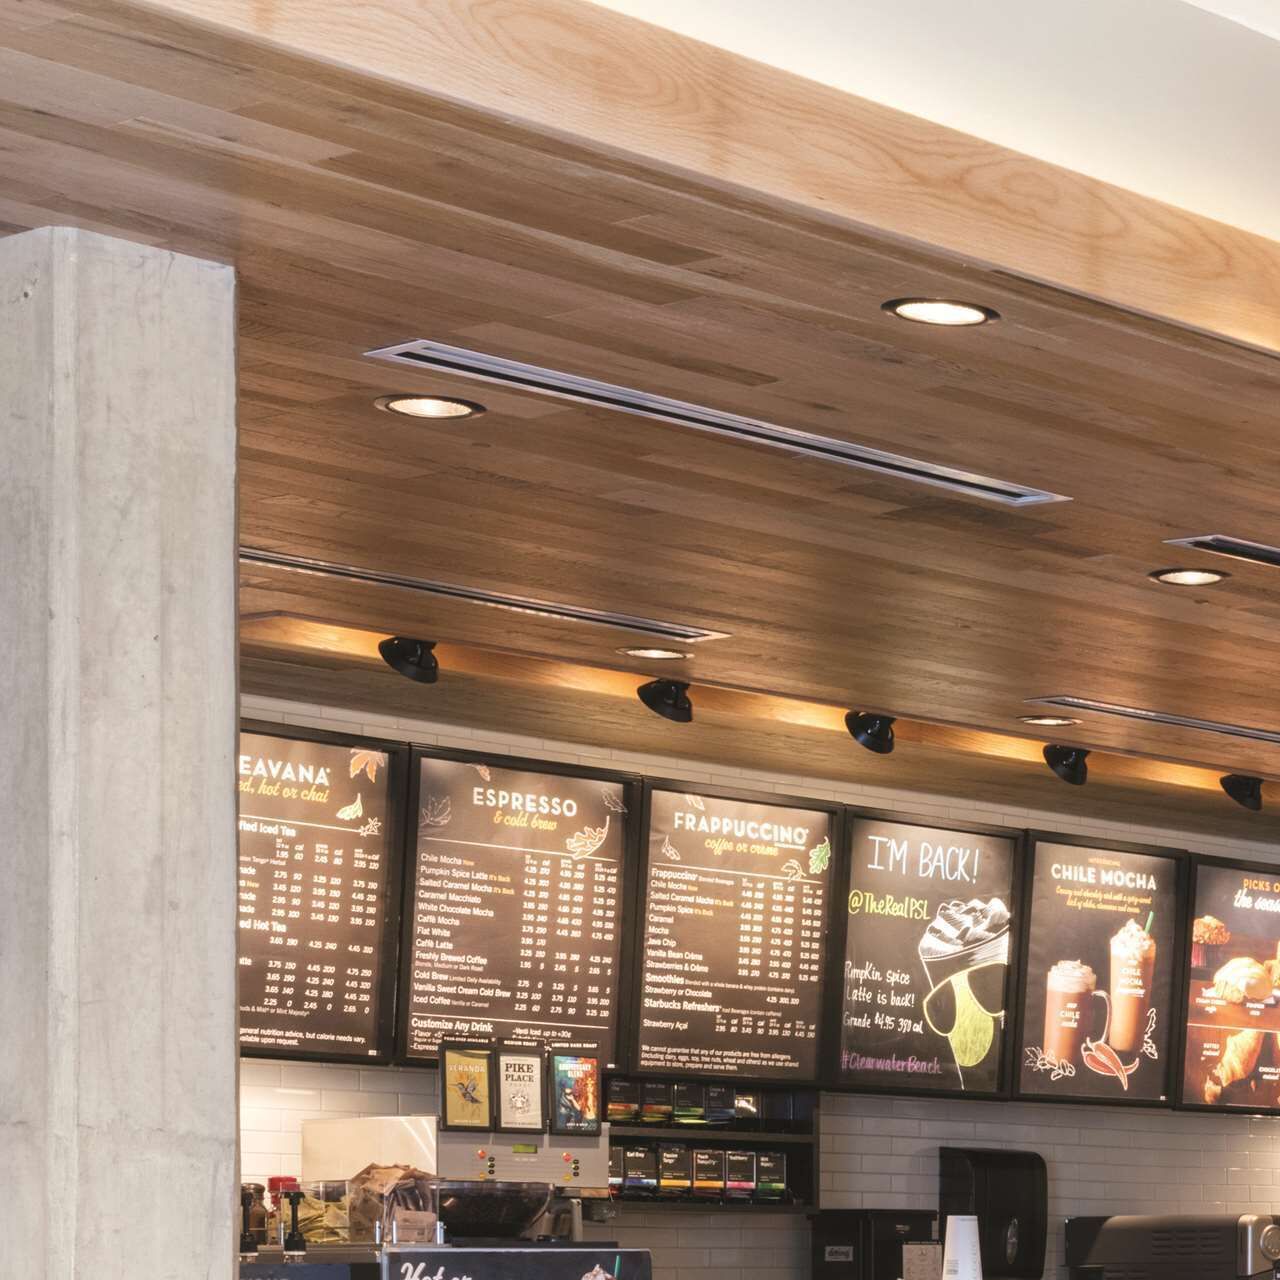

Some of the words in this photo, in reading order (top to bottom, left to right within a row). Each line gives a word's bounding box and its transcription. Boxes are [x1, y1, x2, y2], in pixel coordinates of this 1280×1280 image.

[239, 755, 330, 786] EAVANA
[258, 779, 281, 796] hot
[282, 787, 298, 798] or
[301, 785, 329, 803] chai
[472, 786, 577, 817] ESPRESSO
[503, 812, 528, 828] cold
[531, 814, 558, 831] brew
[440, 855, 462, 865] Mocha
[868, 835, 908, 875] I'M
[918, 841, 979, 884] BACK!
[420, 866, 449, 877] Pumpkin
[452, 869, 470, 880] Spice
[471, 871, 488, 880] Latte
[1051, 864, 1096, 883] CHILE
[1101, 869, 1156, 890] MOCHA
[419, 878, 441, 888] Salted
[443, 880, 469, 891] Caramel
[471, 883, 493, 893] Mocha
[1243, 879, 1271, 892] PICKS
[418, 890, 447, 900] Caramel
[449, 893, 481, 904] Macchiato
[848, 889, 931, 920] @TheRealPSL
[1234, 889, 1252, 909] the
[418, 902, 438, 912] White
[439, 904, 471, 915] Chocolate
[473, 907, 494, 917] Mocha
[437, 916, 460, 926] Mocha
[417, 927, 431, 936] Flat
[431, 928, 450, 937] White
[436, 941, 453, 950] Latte
[416, 951, 439, 962] Freshly
[440, 953, 465, 963] Brewed
[466, 955, 487, 965] Coffee
[414, 971, 430, 980] Cold
[431, 972, 448, 981] Brew
[886, 968, 910, 986] spice
[414, 983, 435, 993] Vanilla
[437, 985, 456, 995] Sweet
[458, 987, 478, 996] Cream
[480, 988, 494, 997] Cold
[495, 989, 511, 998] Brew
[846, 987, 872, 1001] Latte
[877, 991, 887, 1005] is
[413, 995, 428, 1004] Iced
[429, 996, 451, 1006] Coffee
[411, 1018, 454, 1031] Customize
[455, 1020, 469, 1033] Any
[471, 1021, 493, 1032] Drink
[843, 1012, 871, 1028] Grande
[505, 1063, 534, 1073] PIKE
[505, 1074, 534, 1083] PLACE
